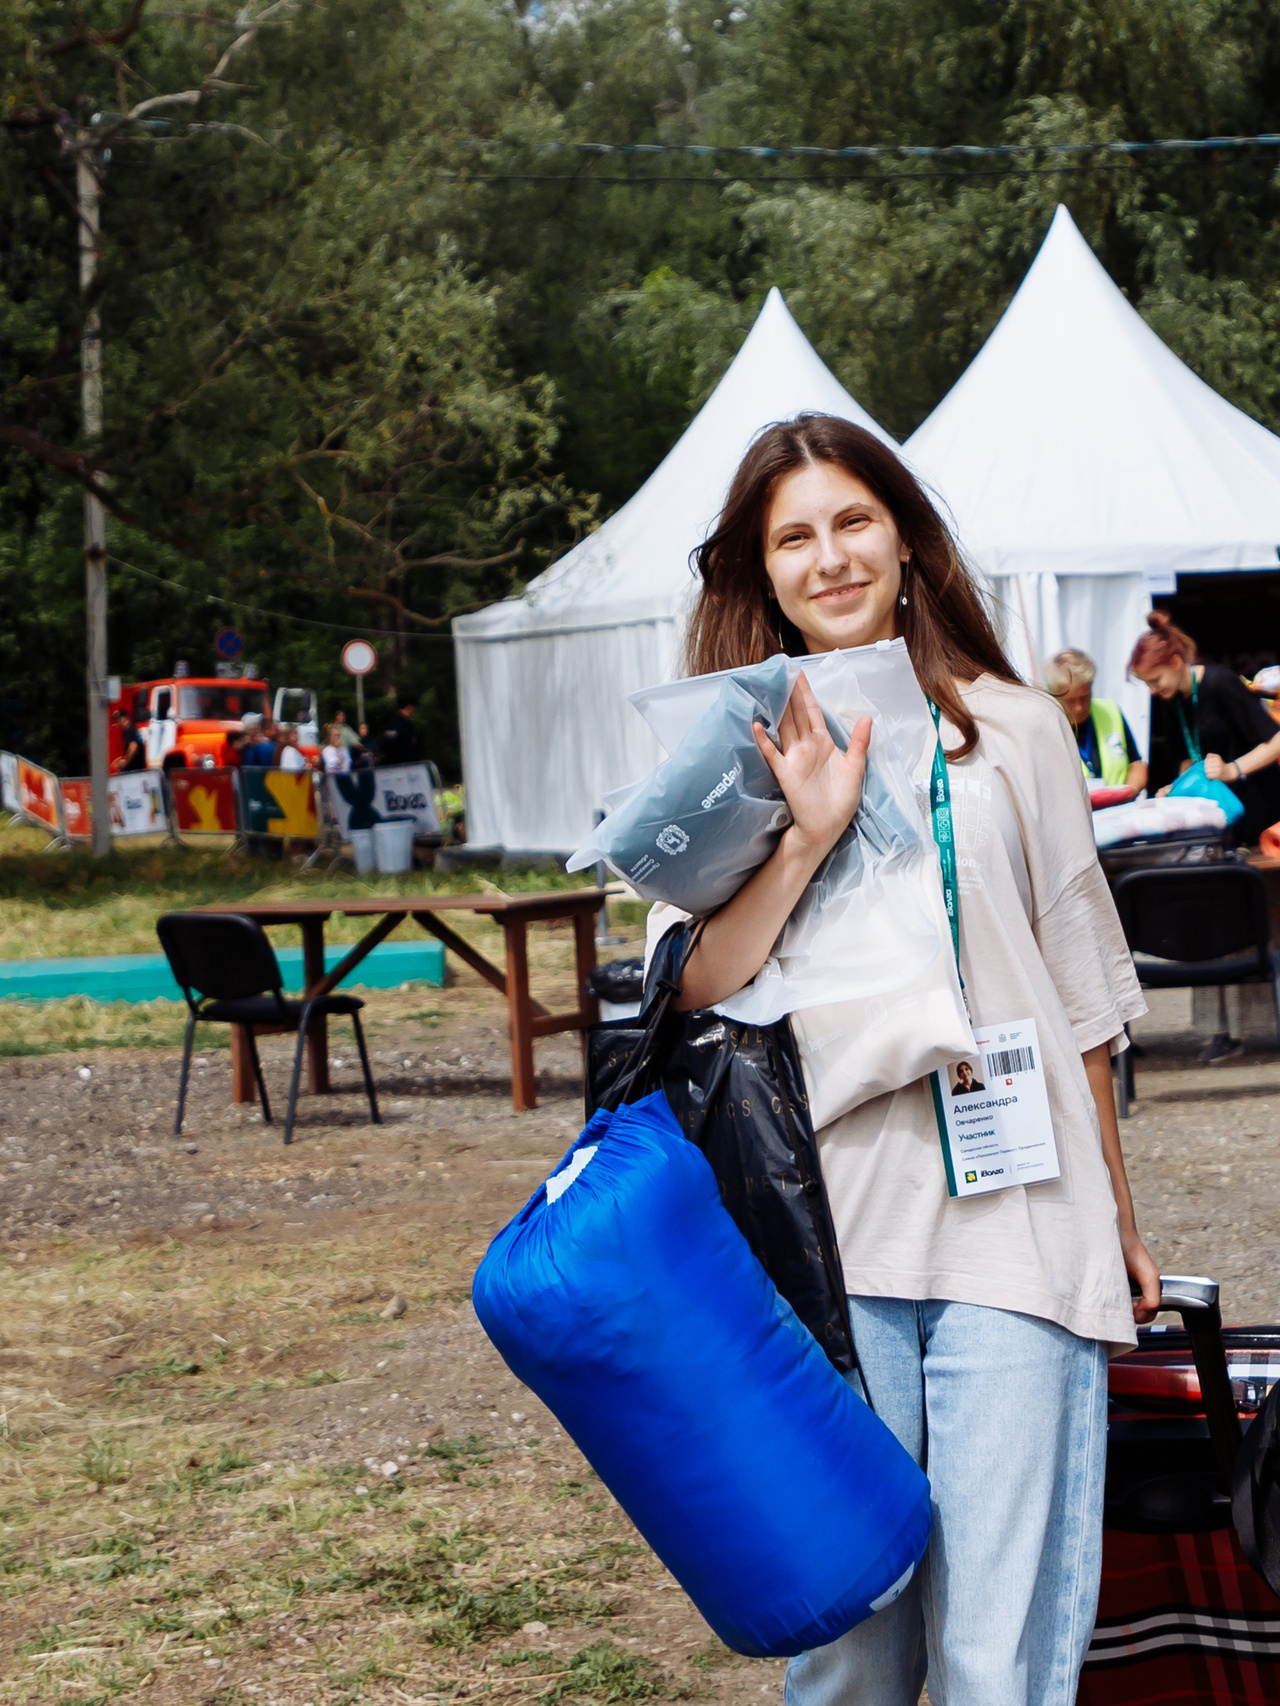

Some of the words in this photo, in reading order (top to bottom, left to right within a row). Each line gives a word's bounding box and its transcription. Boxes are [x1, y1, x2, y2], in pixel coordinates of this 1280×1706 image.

[953, 1095, 1018, 1115] Александра
[955, 1114, 994, 1127] Овчаренко
[958, 1129, 996, 1142] Участник
